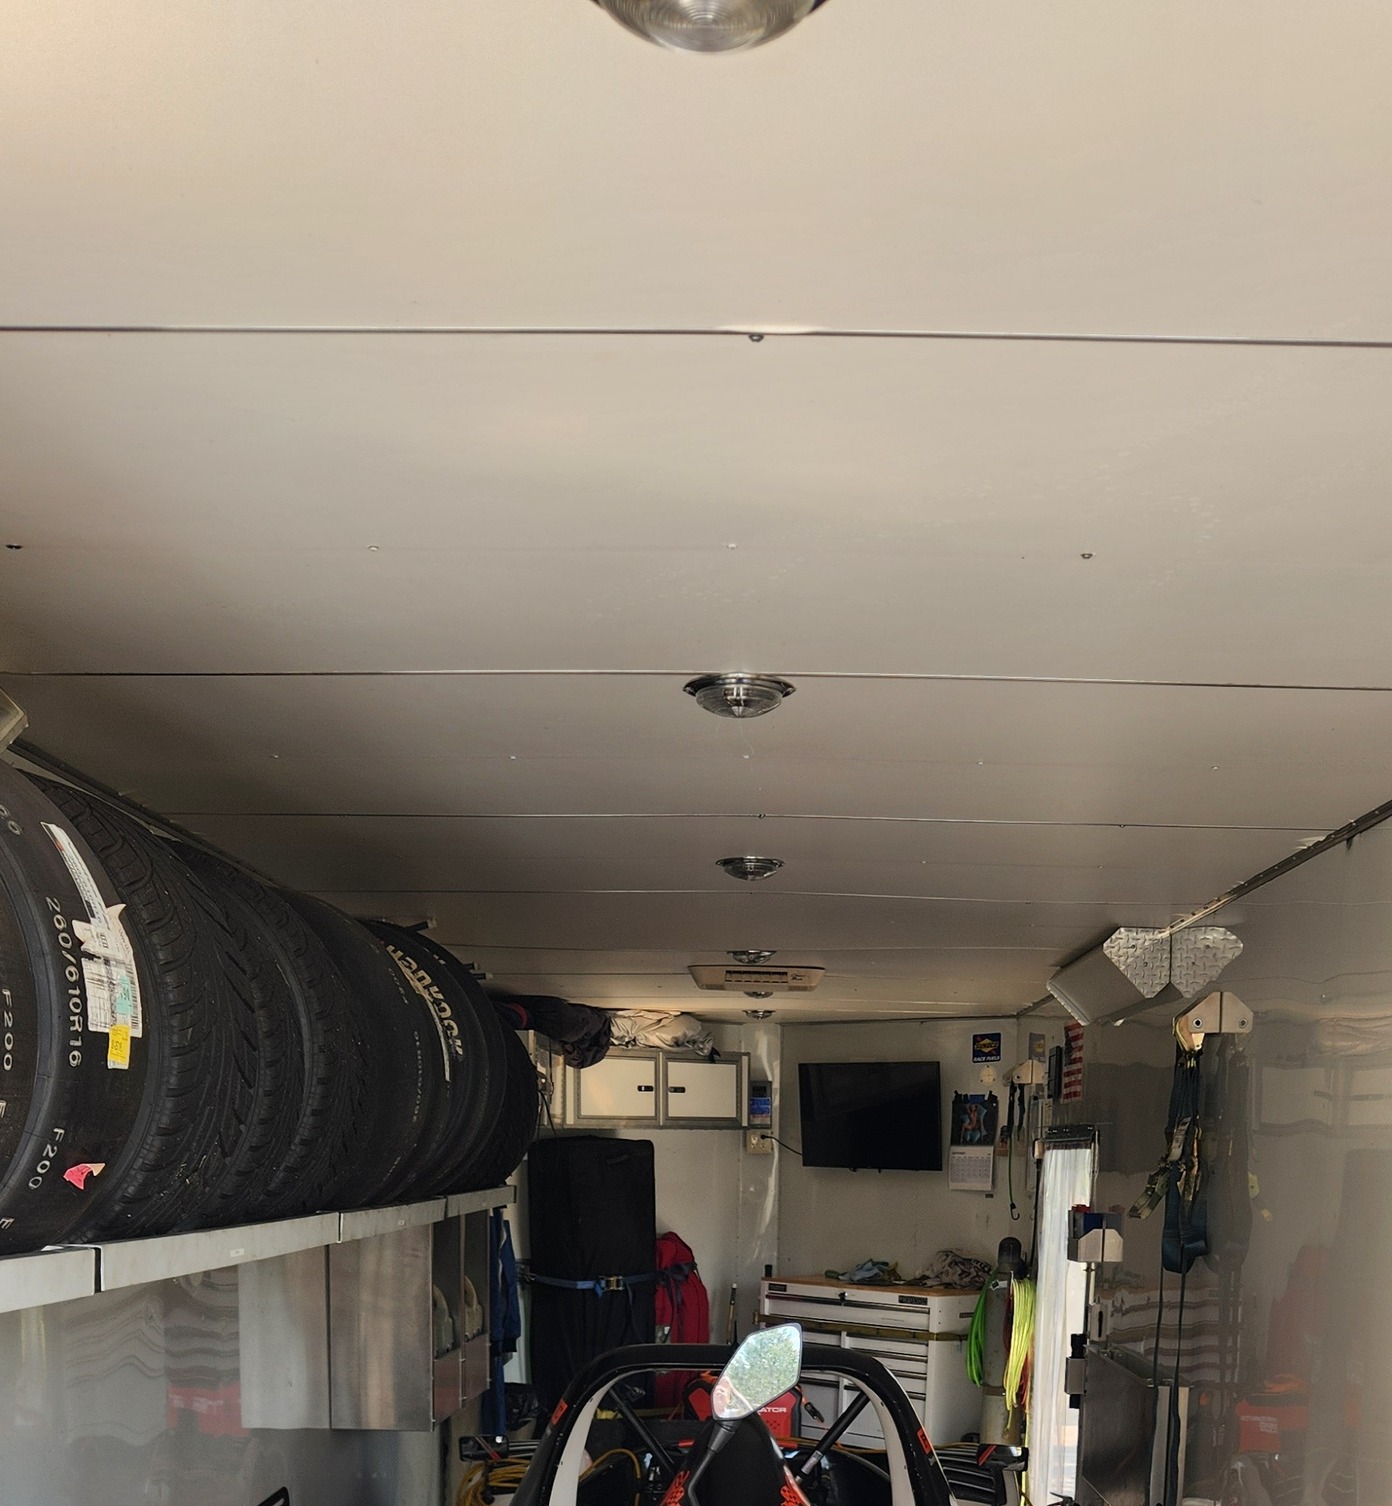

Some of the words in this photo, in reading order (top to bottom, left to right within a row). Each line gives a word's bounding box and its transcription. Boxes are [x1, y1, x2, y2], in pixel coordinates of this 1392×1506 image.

[46, 897, 83, 1067] 260/610R16
[2, 988, 14, 1071] F200
[28, 1127, 65, 1190] F200
